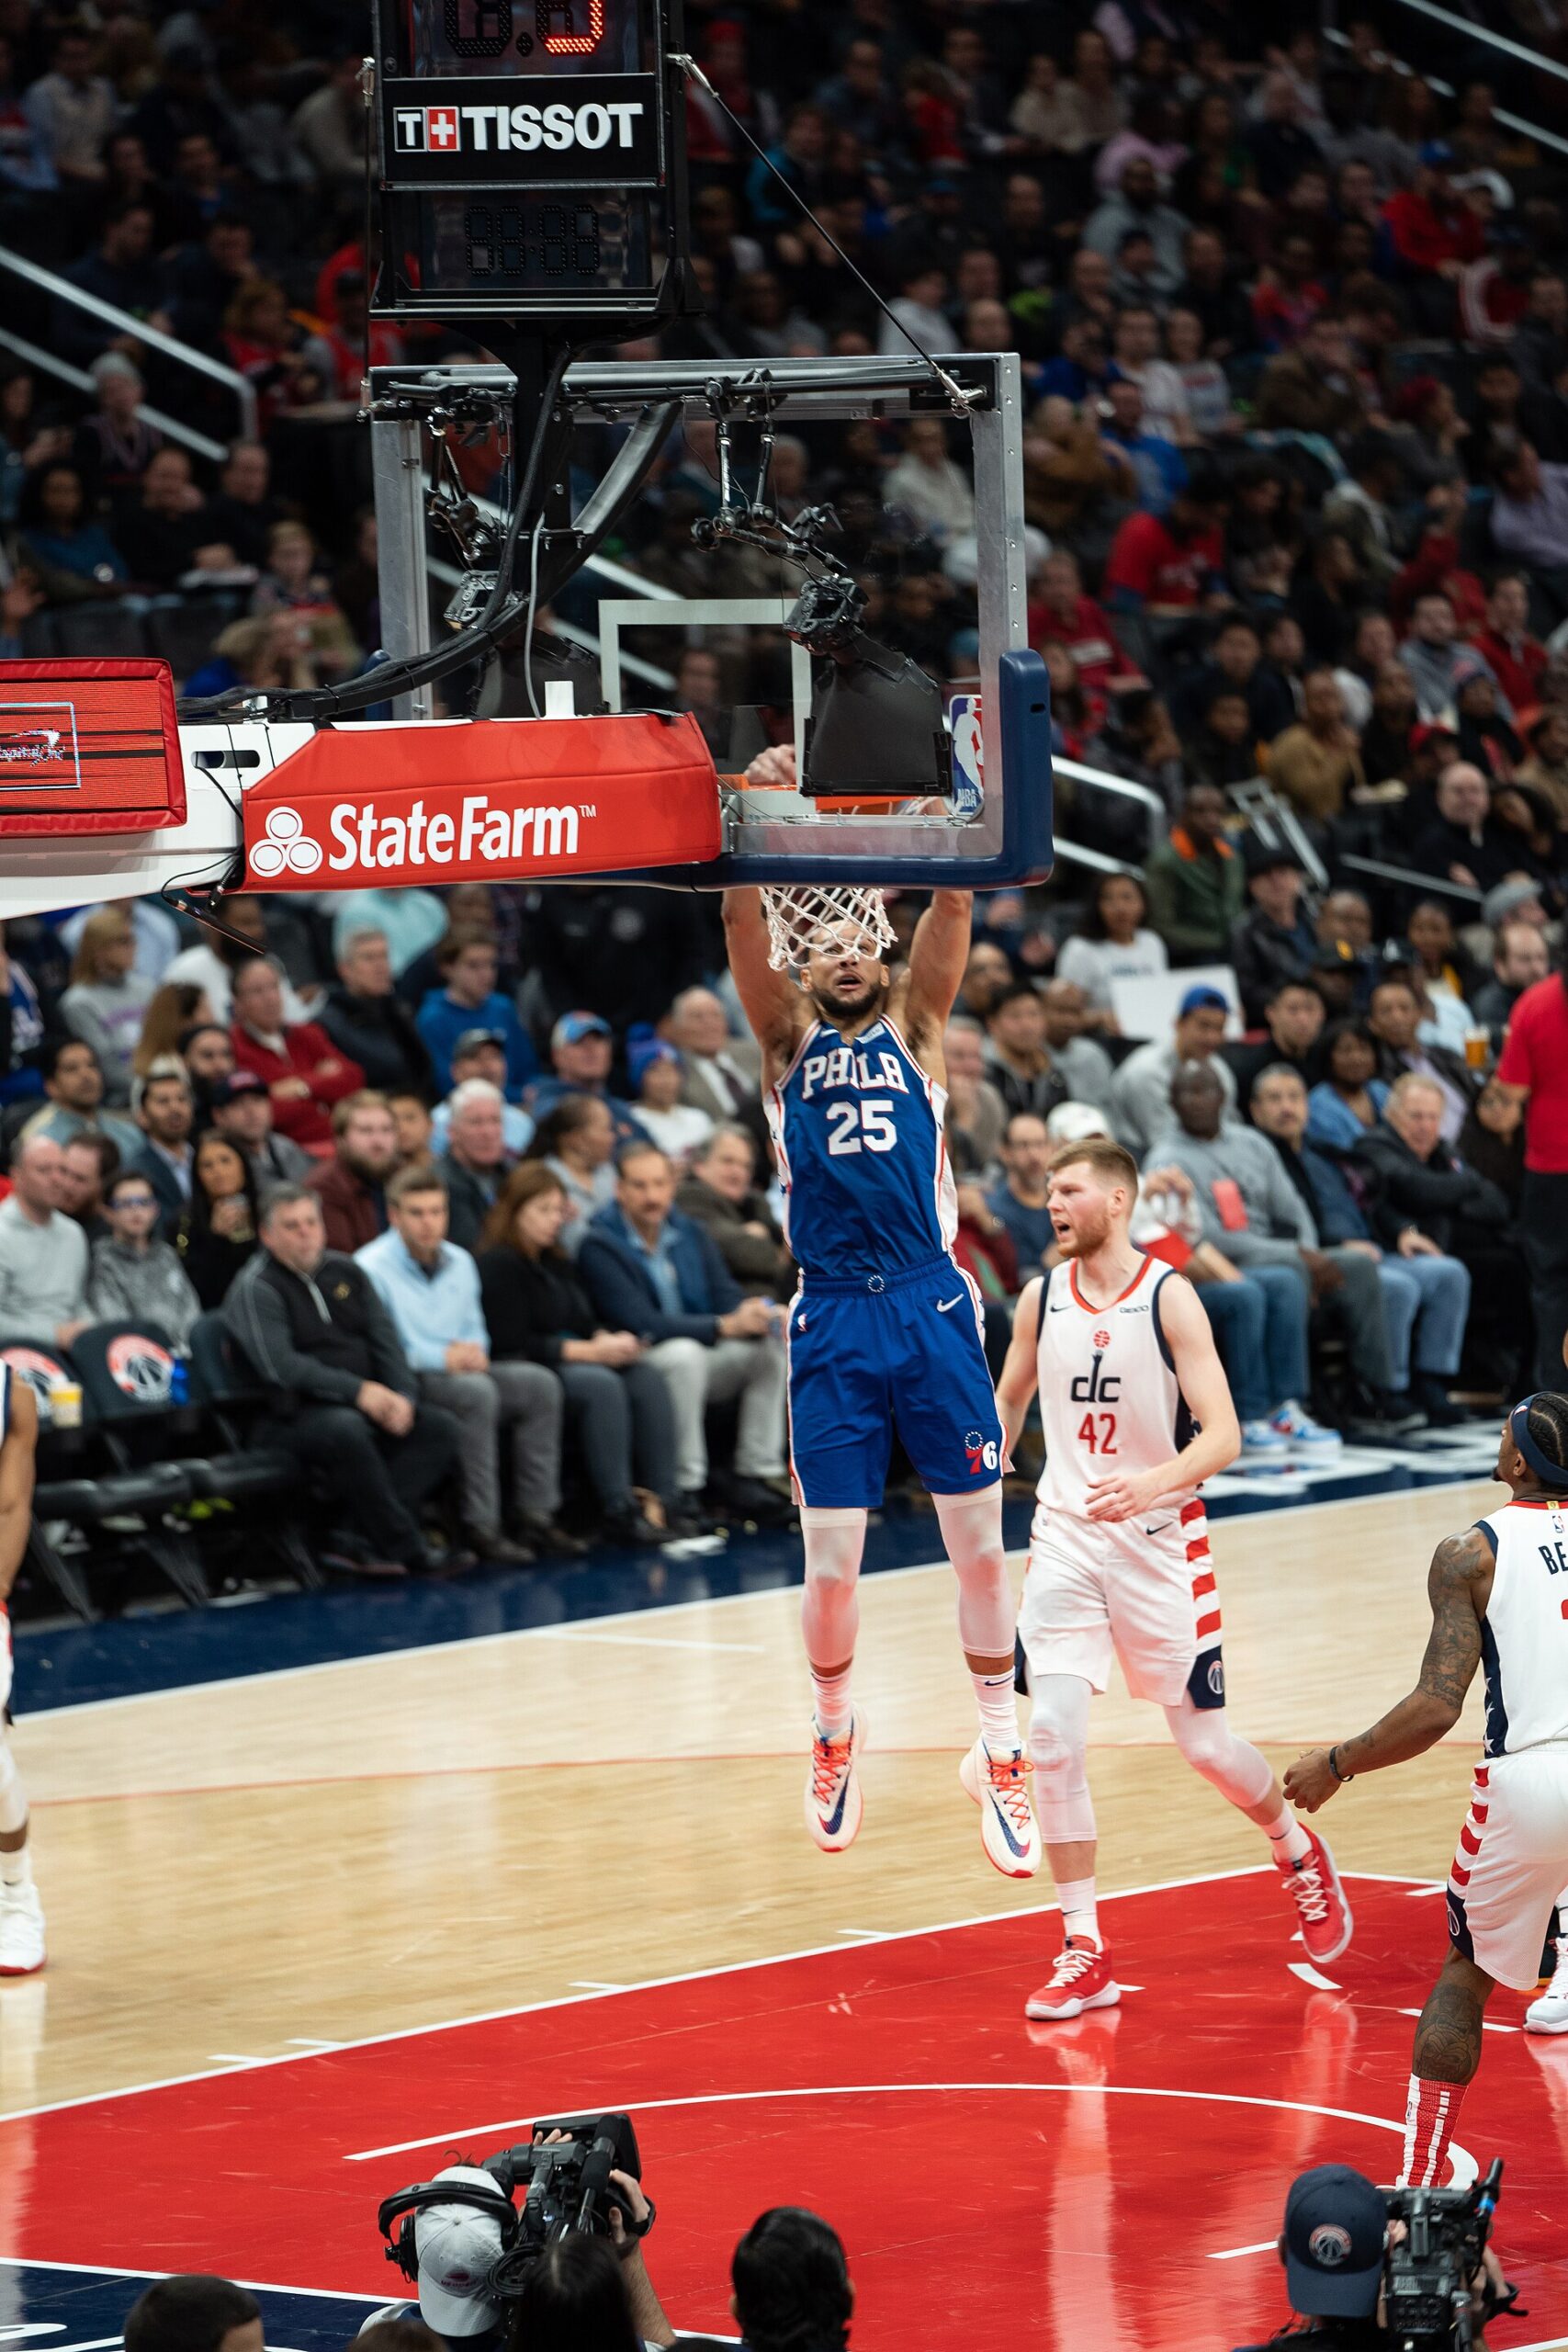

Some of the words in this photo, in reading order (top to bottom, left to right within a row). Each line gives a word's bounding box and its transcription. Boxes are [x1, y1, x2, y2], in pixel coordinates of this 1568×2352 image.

[461, 103, 644, 152] TISSOT
[802, 1046, 910, 1100] PHILA
[826, 1099, 898, 1156] 25
[1078, 1412, 1118, 1454] 42
[965, 1441, 998, 1476] 76
